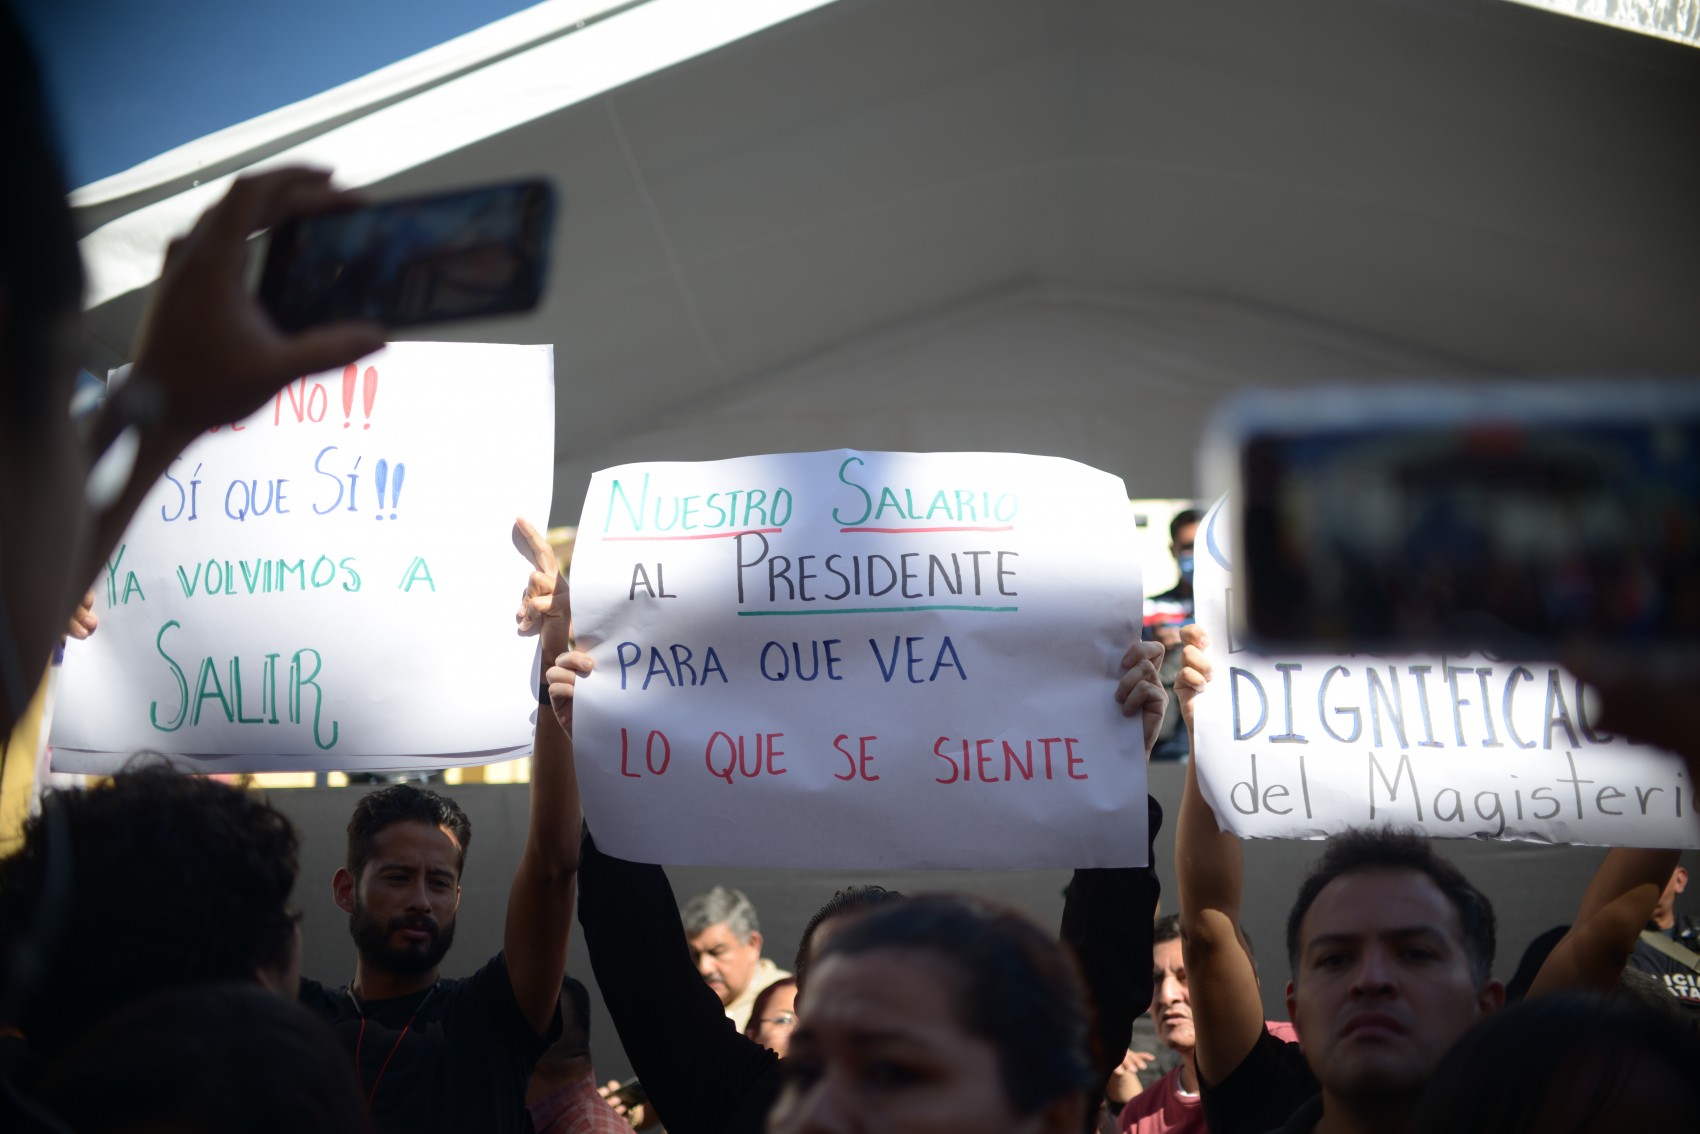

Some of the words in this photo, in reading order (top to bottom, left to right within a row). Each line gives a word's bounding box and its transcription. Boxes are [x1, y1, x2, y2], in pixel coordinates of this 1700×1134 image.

[224, 478, 291, 522] QUE
[603, 473, 793, 533] NUESTRO
[832, 456, 1019, 526] SALARIO
[176, 555, 362, 599] VOLVIMOS
[398, 556, 437, 593] A
[629, 562, 678, 601] AL
[733, 531, 1020, 604] PRESIDENTE
[150, 620, 339, 750] SALIR
[616, 640, 729, 691] PARA
[759, 639, 843, 682] QUE
[869, 635, 968, 684] VEA
[620, 727, 671, 779] LO
[704, 731, 787, 784] QUE
[833, 734, 881, 782] SE
[932, 736, 1090, 784] SIENTE
[1230, 753, 1314, 820] del
[1368, 751, 1684, 837] Magisteri
